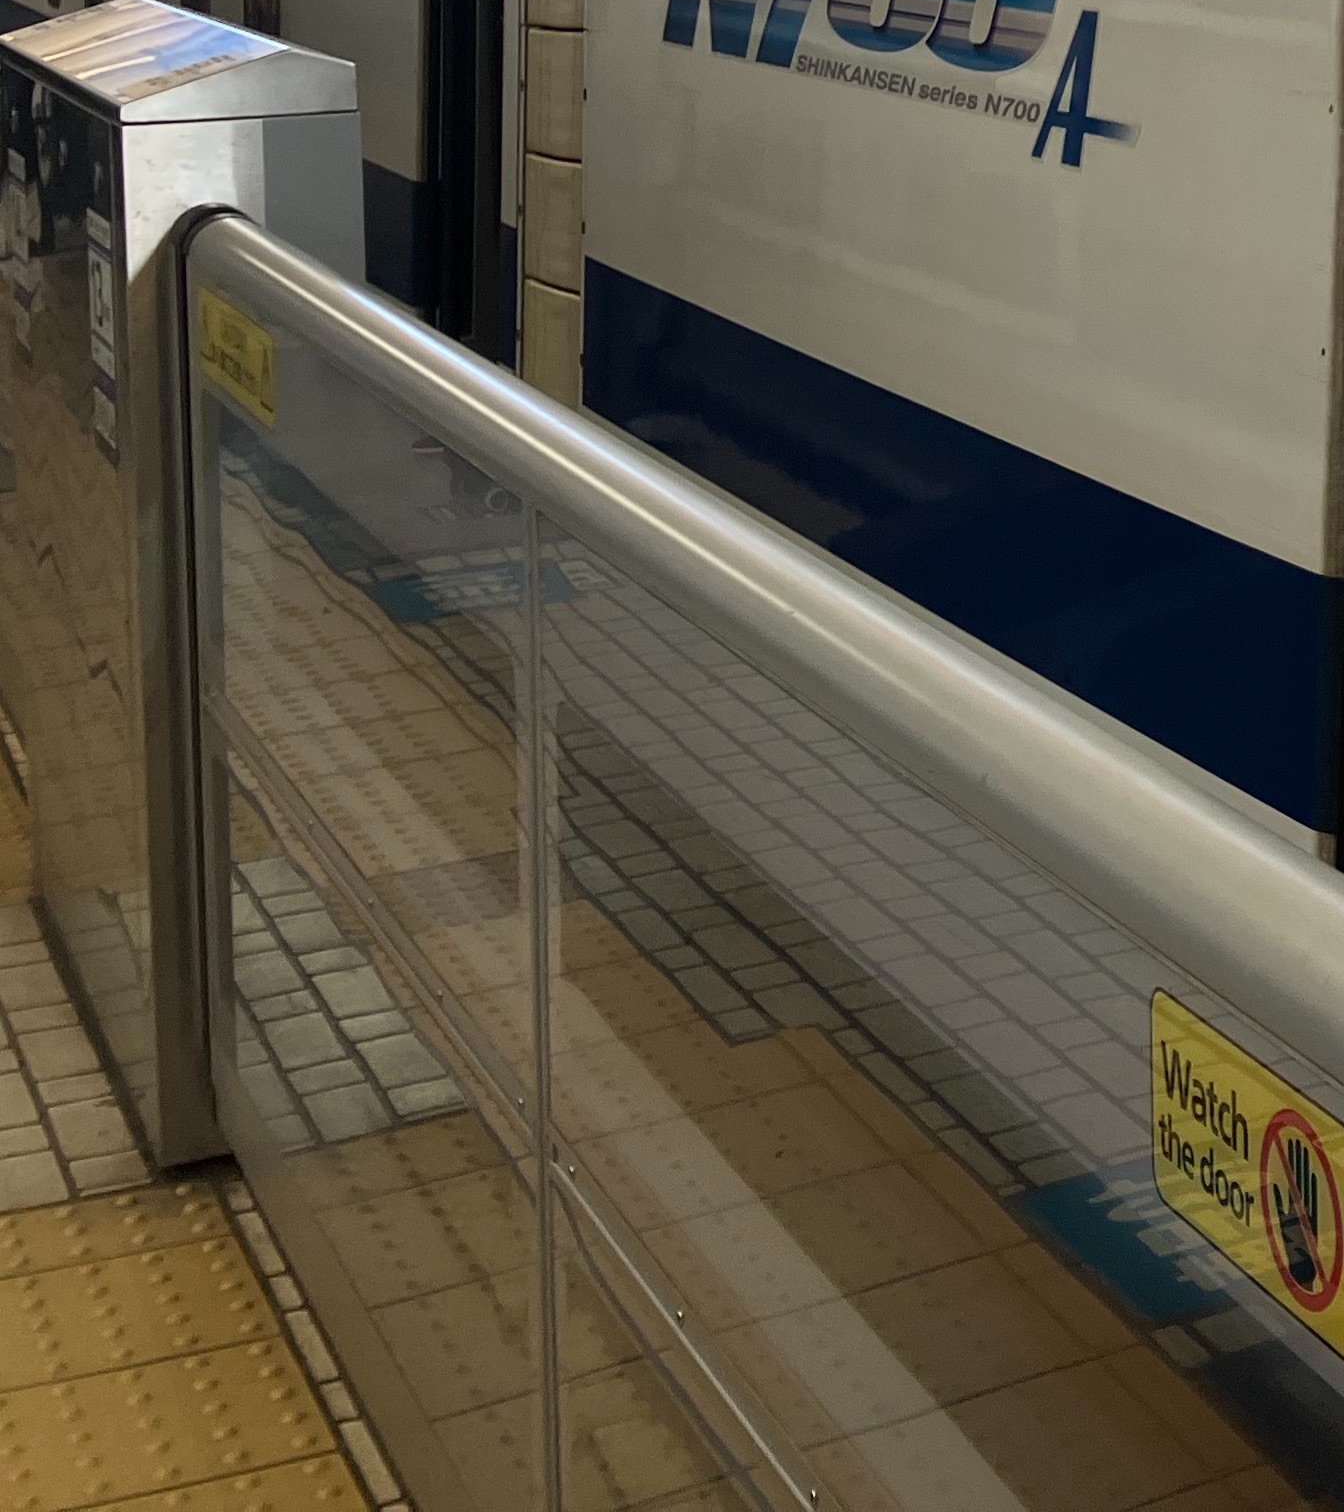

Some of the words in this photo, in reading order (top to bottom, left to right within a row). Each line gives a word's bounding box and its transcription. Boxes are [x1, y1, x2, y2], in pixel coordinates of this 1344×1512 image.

[796, 54, 917, 97] SHINKANSEN
[919, 84, 978, 110] series
[984, 92, 1041, 123] N700
[1161, 1039, 1249, 1161] Watch
[1158, 1114, 1195, 1180] the
[1201, 1147, 1254, 1228] door
